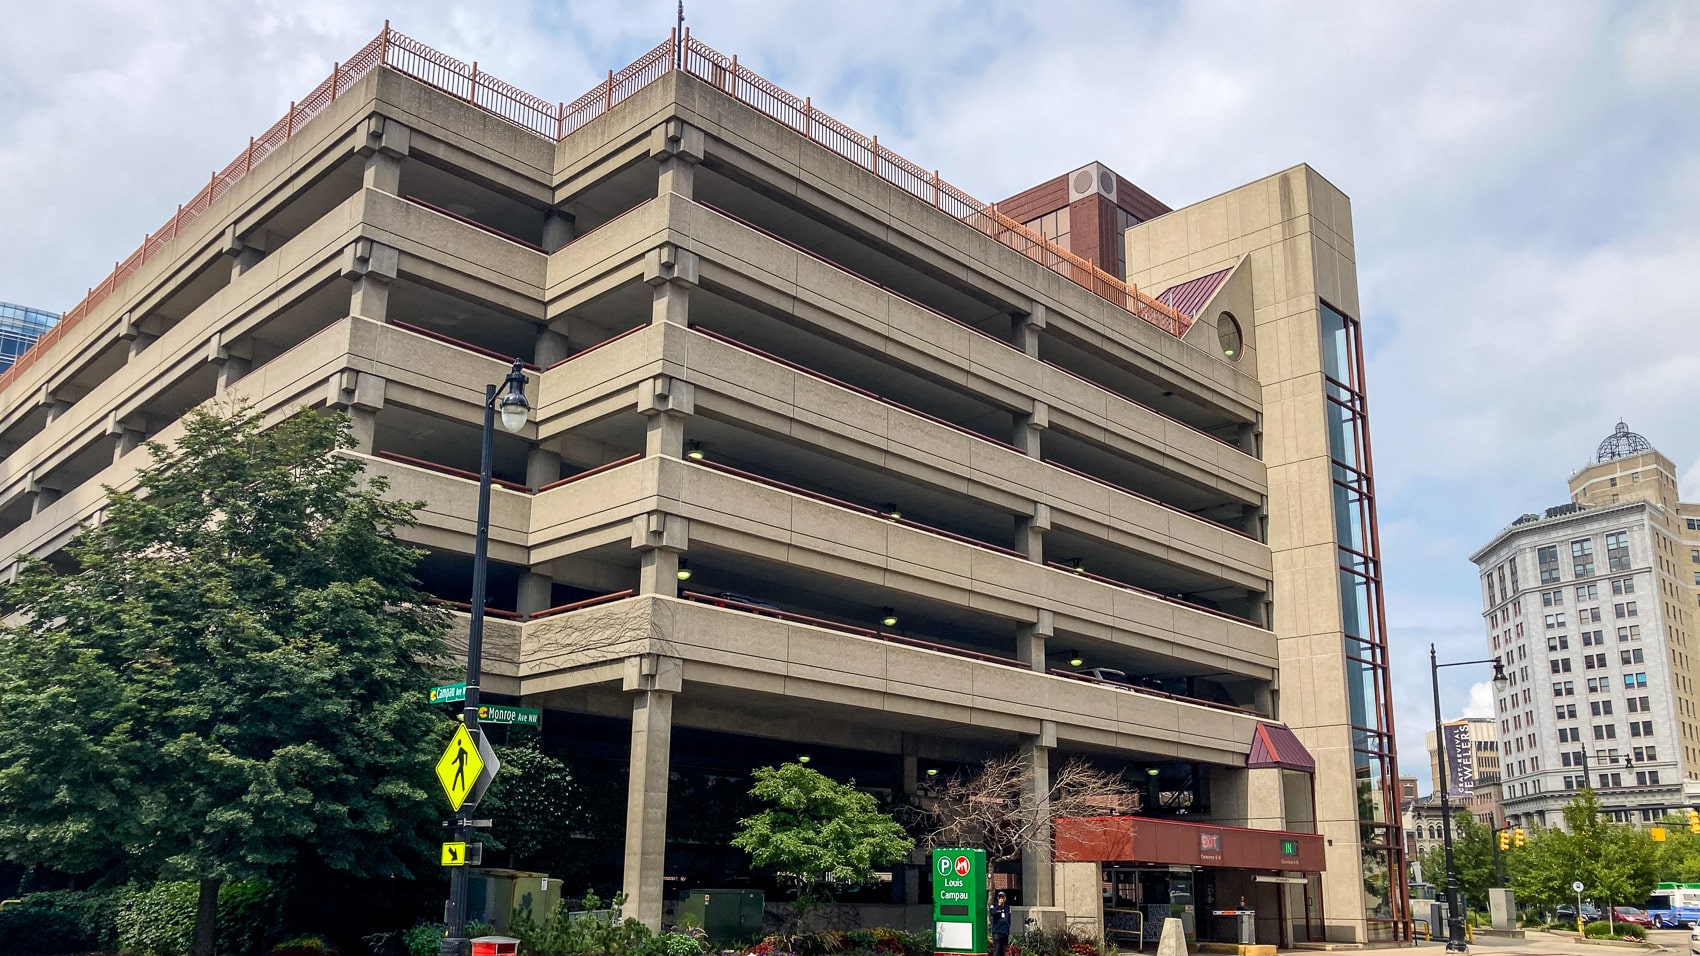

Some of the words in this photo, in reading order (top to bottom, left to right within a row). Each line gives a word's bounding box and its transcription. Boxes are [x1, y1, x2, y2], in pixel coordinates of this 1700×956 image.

[436, 687, 455, 699] Campau
[488, 707, 516, 720] Monroe
[518, 713, 527, 722] Ave
[528, 714, 538, 722] NW
[1460, 724, 1474, 796] JEWELERS
[1201, 835, 1216, 848] EXIT
[1285, 842, 1292, 854] IN
[941, 859, 950, 873] P
[944, 878, 963, 887] Louis
[940, 890, 968, 901] Campau
